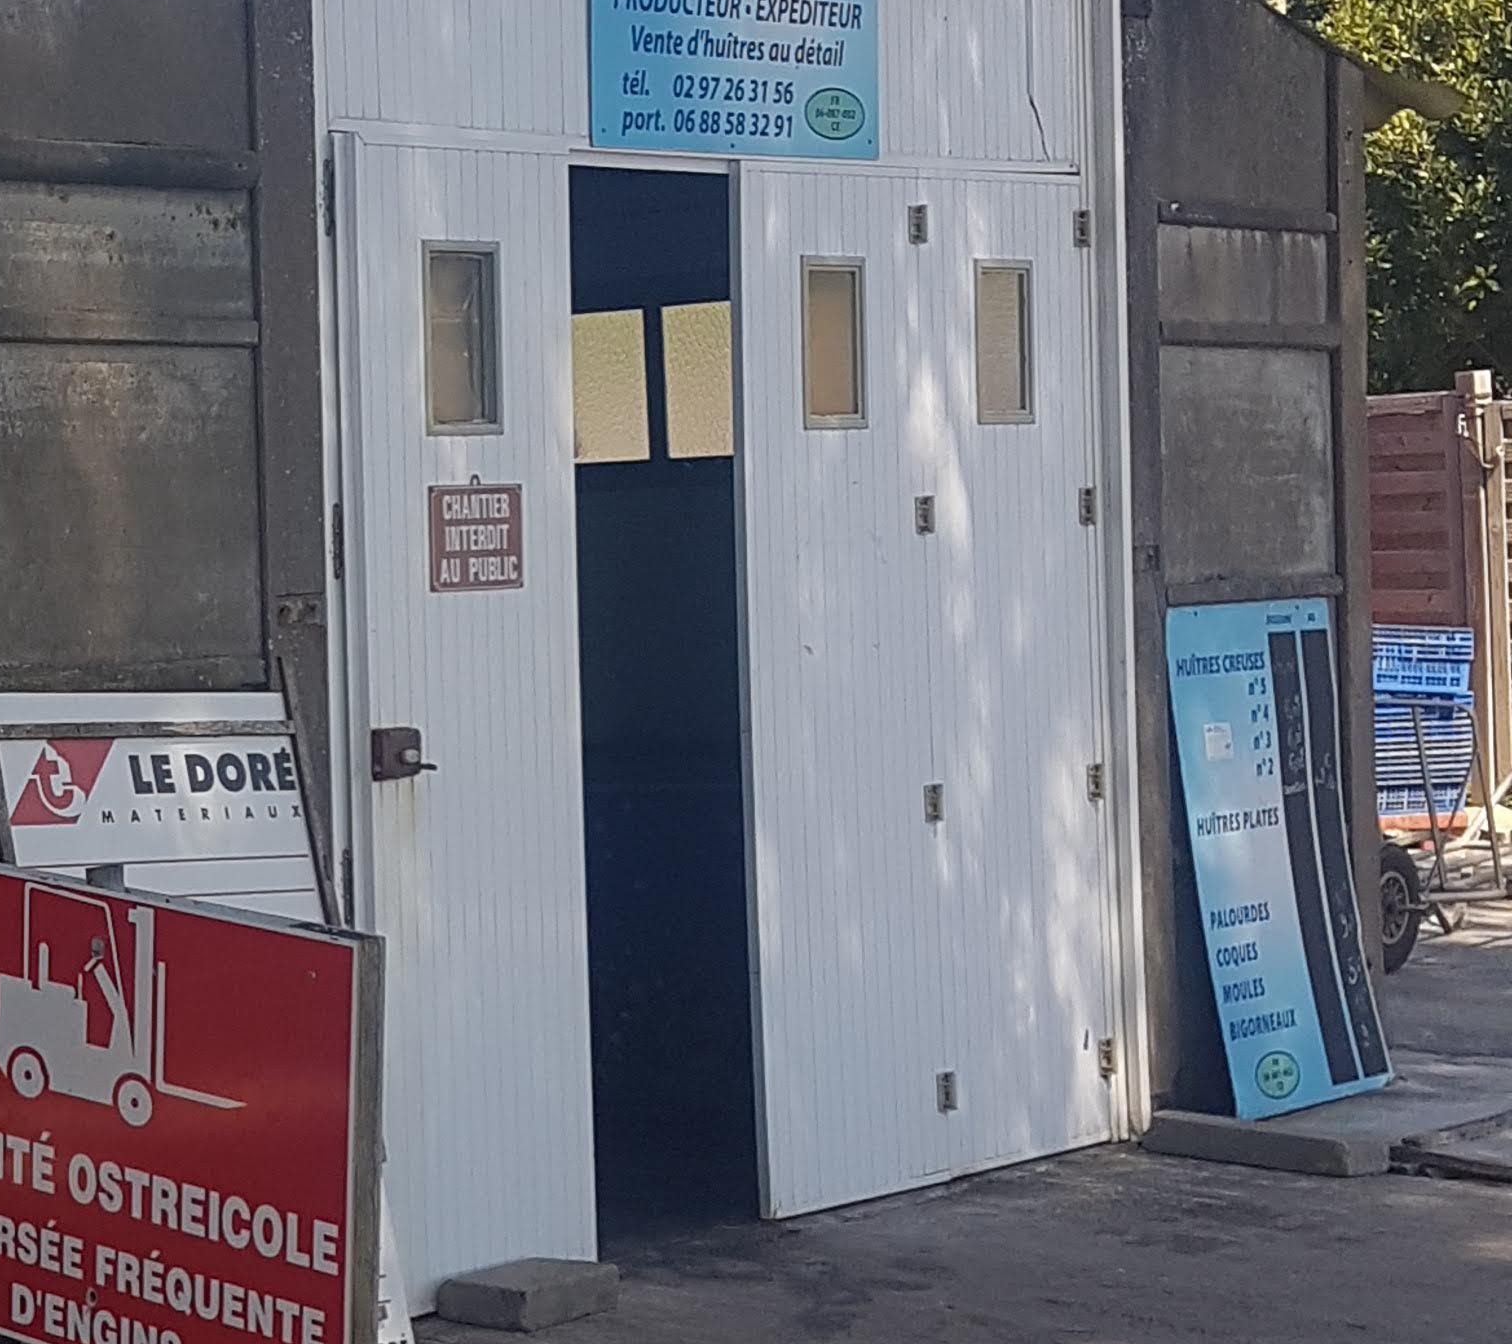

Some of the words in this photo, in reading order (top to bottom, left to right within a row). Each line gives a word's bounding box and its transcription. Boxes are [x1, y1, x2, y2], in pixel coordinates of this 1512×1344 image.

[631, 25, 683, 55] Vente
[688, 29, 764, 61] d'huîtres
[769, 46, 790, 62] au
[795, 37, 845, 66] détail
[622, 70, 649, 96] tél.
[673, 74, 694, 99] 02
[699, 76, 720, 100] 97
[723, 78, 744, 102] 26
[748, 80, 768, 103] 31
[773, 81, 793, 104] 56
[621, 110, 665, 136] port.
[674, 109, 694, 133] 06
[699, 110, 720, 135] 88
[724, 112, 745, 136] 58
[749, 113, 769, 136] 32
[774, 115, 793, 138] 91
[442, 493, 510, 520] CHANTIER
[445, 524, 510, 551] INTERDIT
[440, 557, 460, 583] AU
[469, 555, 518, 582] PUBLIC
[1176, 653, 1220, 677] HUÎTRES
[1222, 651, 1265, 674] CREUSES
[128, 754, 176, 795] LE
[184, 747, 297, 794] DORÉ
[101, 805, 302, 824] MATERIAUX
[1197, 811, 1241, 837] HUÎTRES
[1243, 807, 1279, 830] PLATES
[1210, 902, 1270, 930] PALOURDES
[1216, 942, 1258, 968] COQUES
[1223, 977, 1266, 1004] MOULES
[1229, 1009, 1297, 1042] BIGORNEAUX
[68, 1153, 339, 1276] OSTREICOLE
